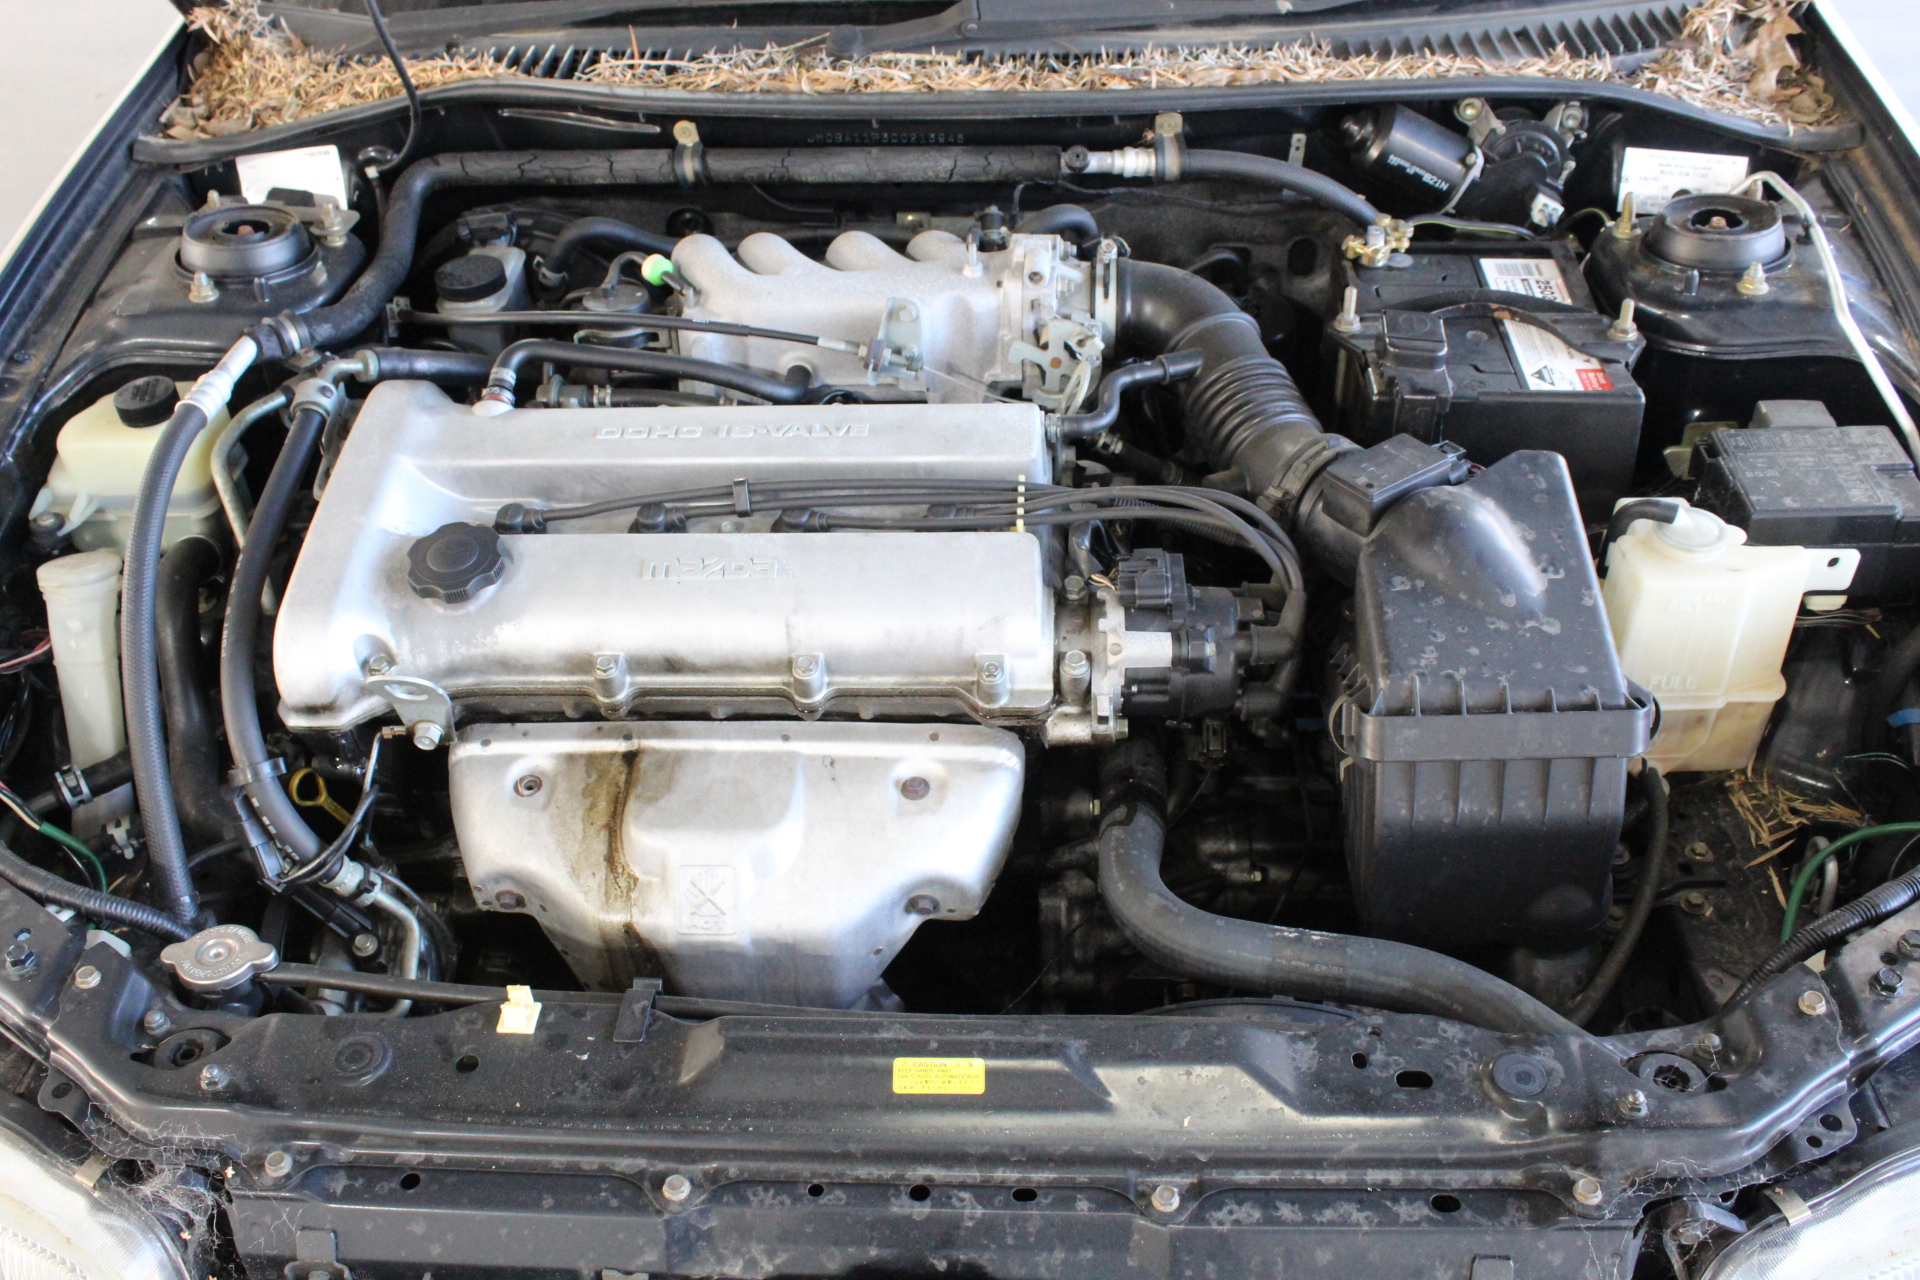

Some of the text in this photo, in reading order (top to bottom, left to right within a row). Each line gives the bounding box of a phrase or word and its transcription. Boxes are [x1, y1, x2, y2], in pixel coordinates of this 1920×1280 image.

[595, 423, 870, 440] DOHC 16-VALVE
[1648, 674, 1697, 690] FULL
